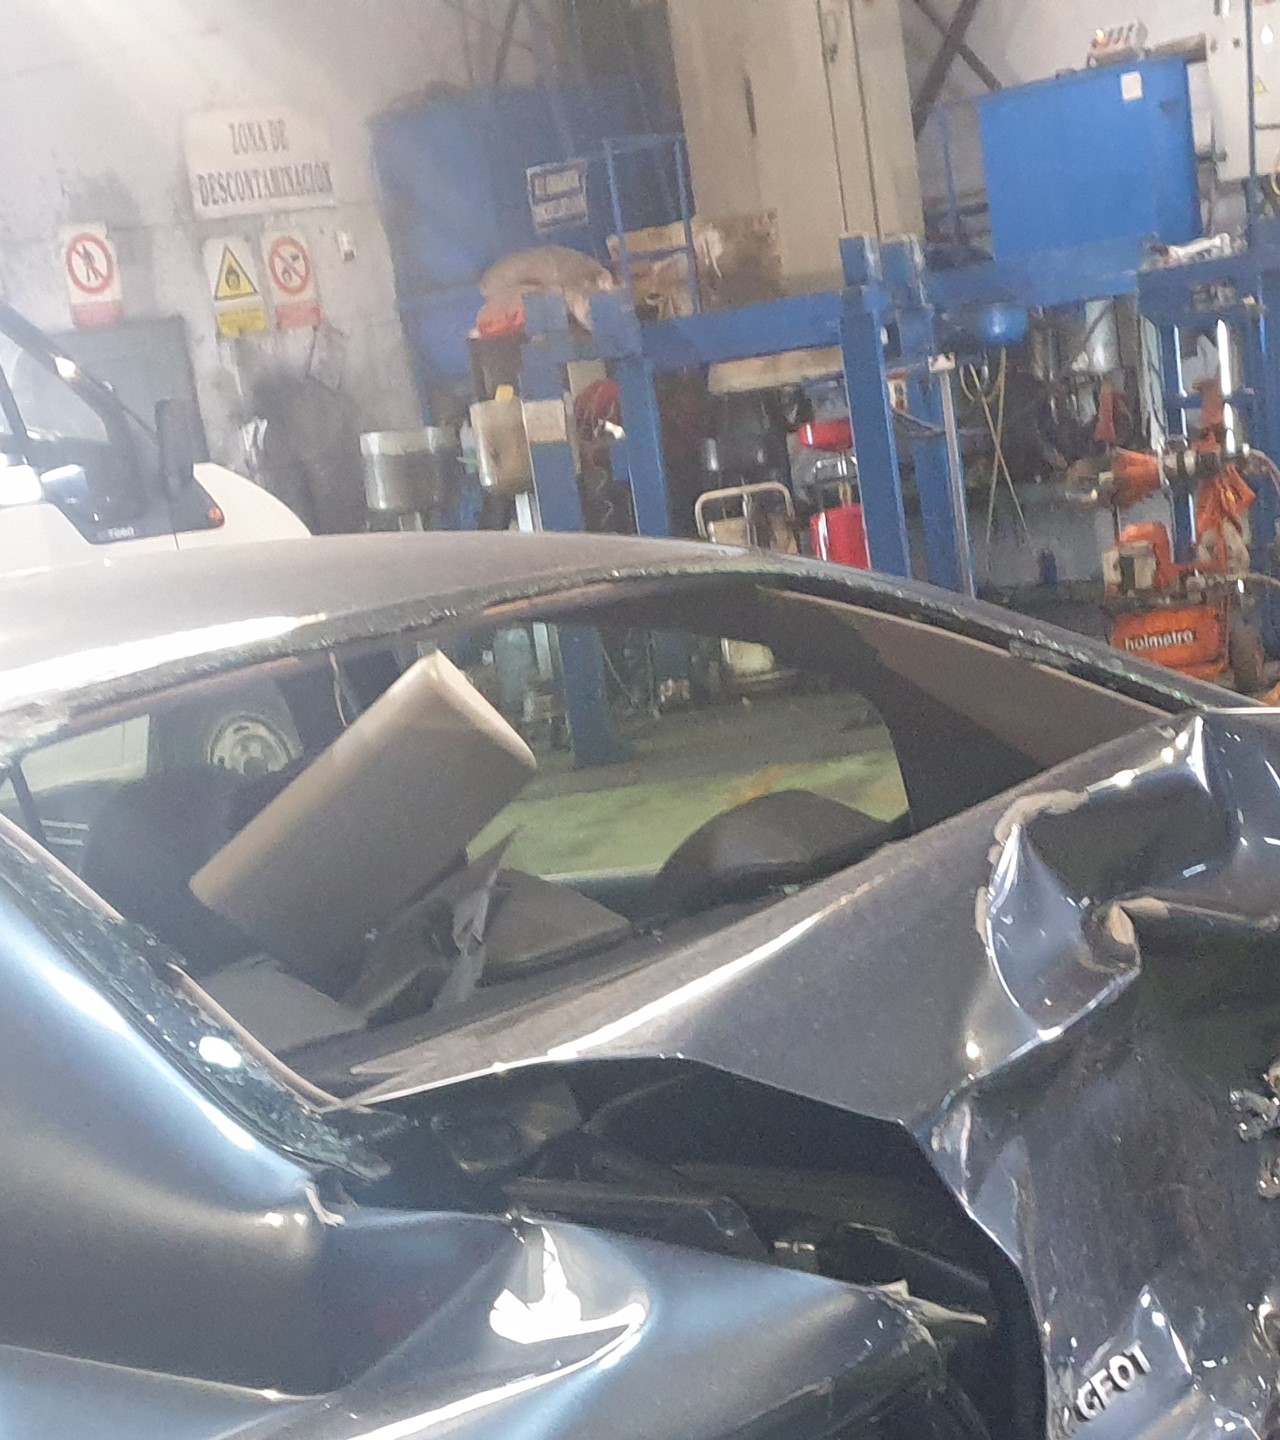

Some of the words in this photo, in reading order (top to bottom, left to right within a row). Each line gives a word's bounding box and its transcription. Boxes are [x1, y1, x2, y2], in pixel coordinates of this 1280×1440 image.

[228, 121, 268, 155] ZONA
[267, 118, 290, 152] DE
[1124, 629, 1194, 652] holmatro
[1063, 1339, 1153, 1430] GEOT
